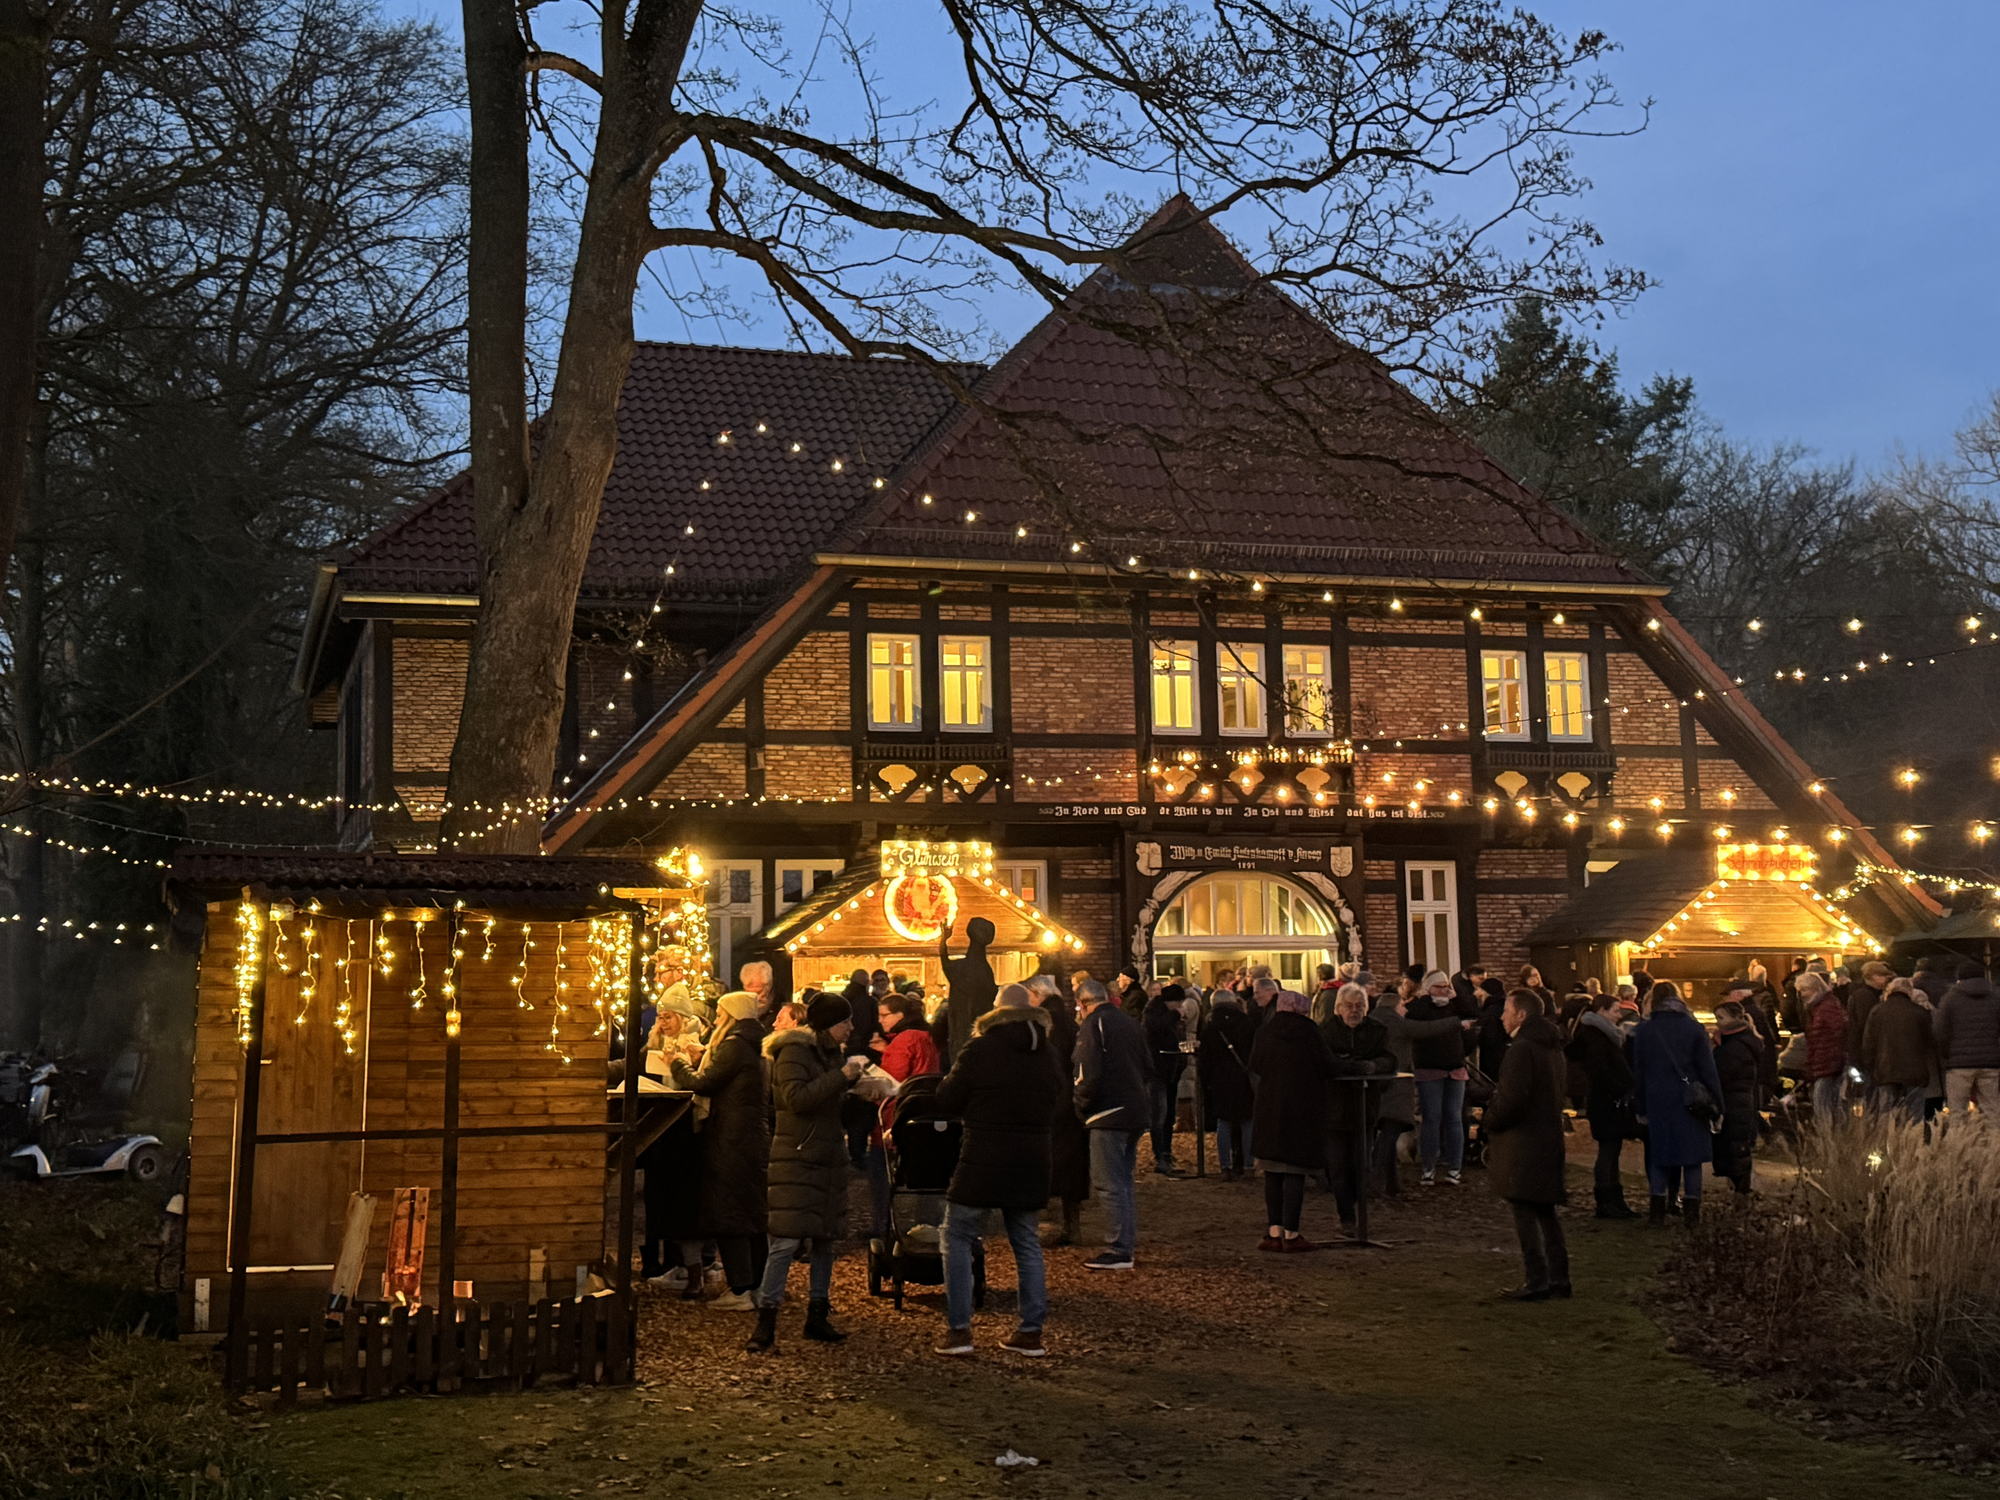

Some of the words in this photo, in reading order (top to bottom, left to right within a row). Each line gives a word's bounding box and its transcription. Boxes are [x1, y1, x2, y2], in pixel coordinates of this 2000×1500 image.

[1072, 806, 1099, 816] Nord
[1104, 806, 1123, 815] und
[1173, 806, 1198, 816] Welt
[1261, 807, 1279, 817] Ost
[1284, 808, 1304, 816] und
[1308, 807, 1335, 817] West
[1346, 808, 1364, 817] dat
